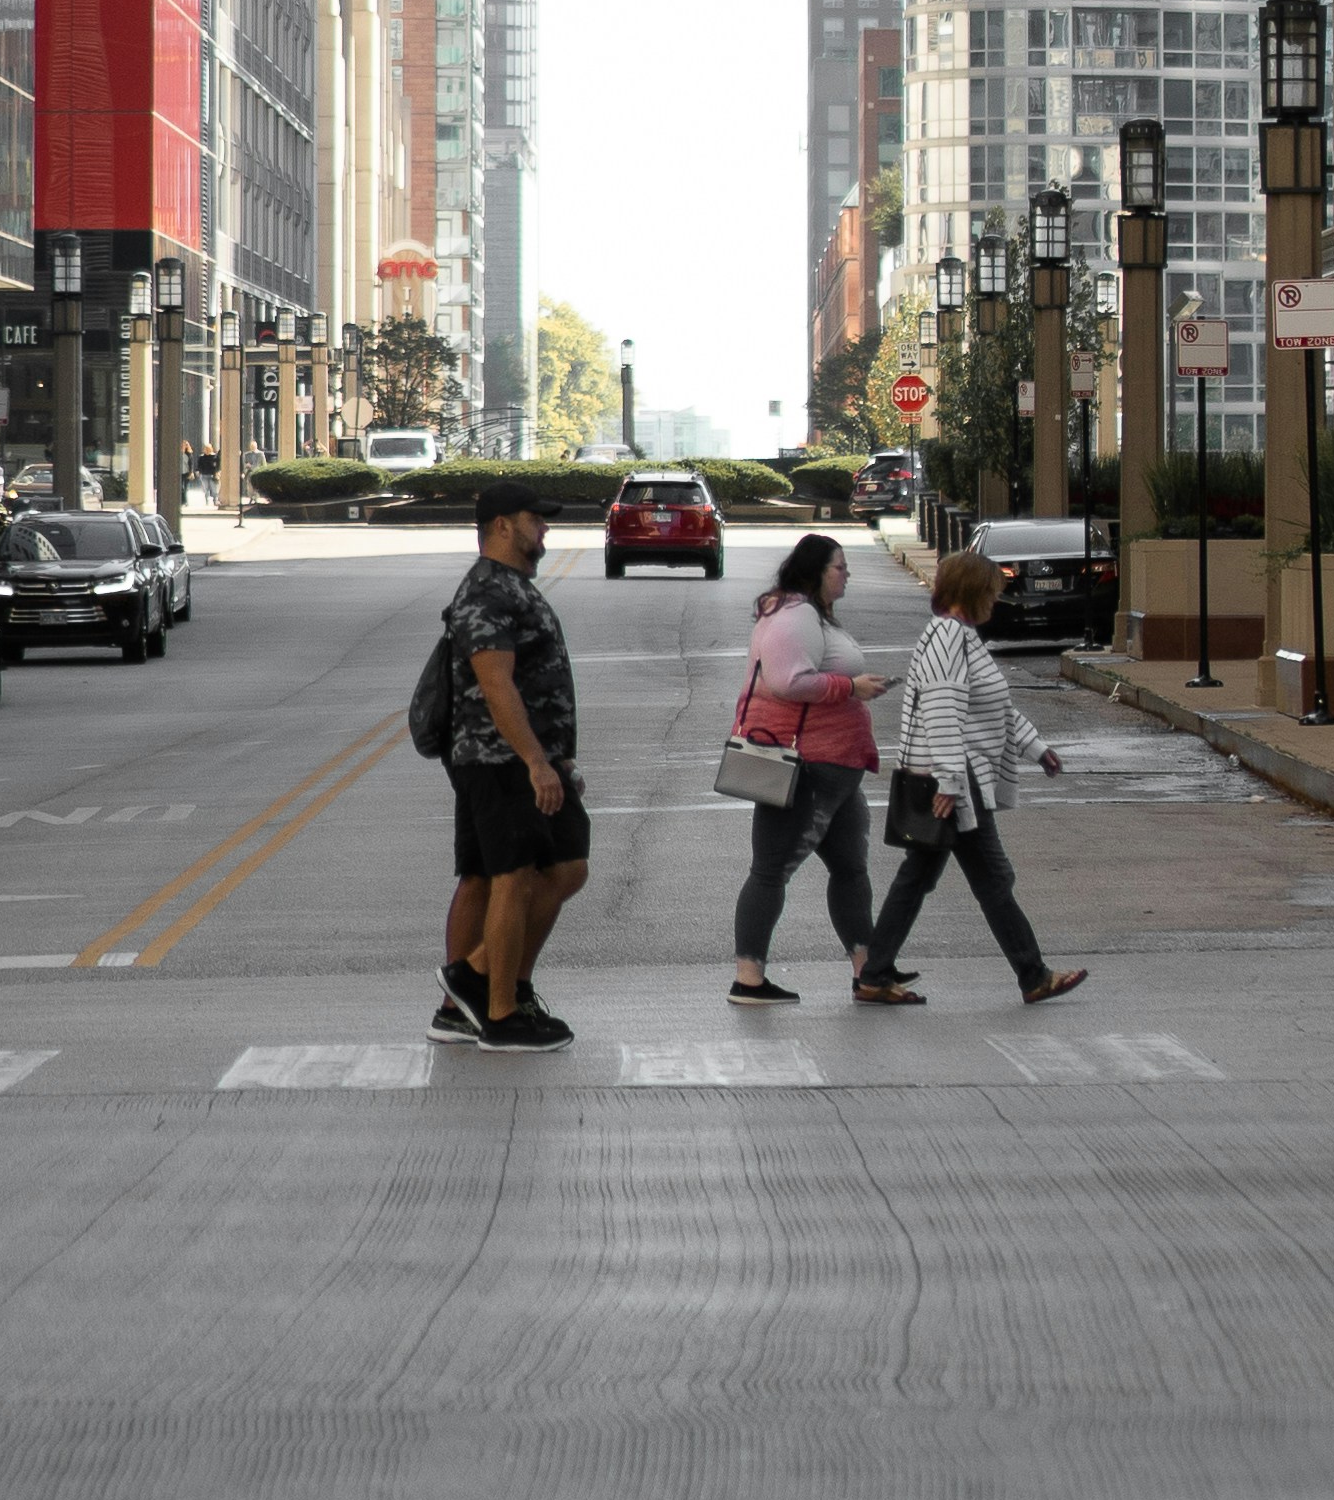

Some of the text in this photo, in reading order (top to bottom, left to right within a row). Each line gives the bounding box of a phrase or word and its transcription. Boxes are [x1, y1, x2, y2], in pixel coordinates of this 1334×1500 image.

[377, 260, 439, 279] amc
[5, 325, 38, 345] CAFE
[1279, 338, 1302, 347] TOW
[900, 343, 918, 352] ONE
[900, 352, 919, 360] WAY
[1181, 367, 1224, 376] TOW ZONE
[894, 386, 928, 402] STOP
